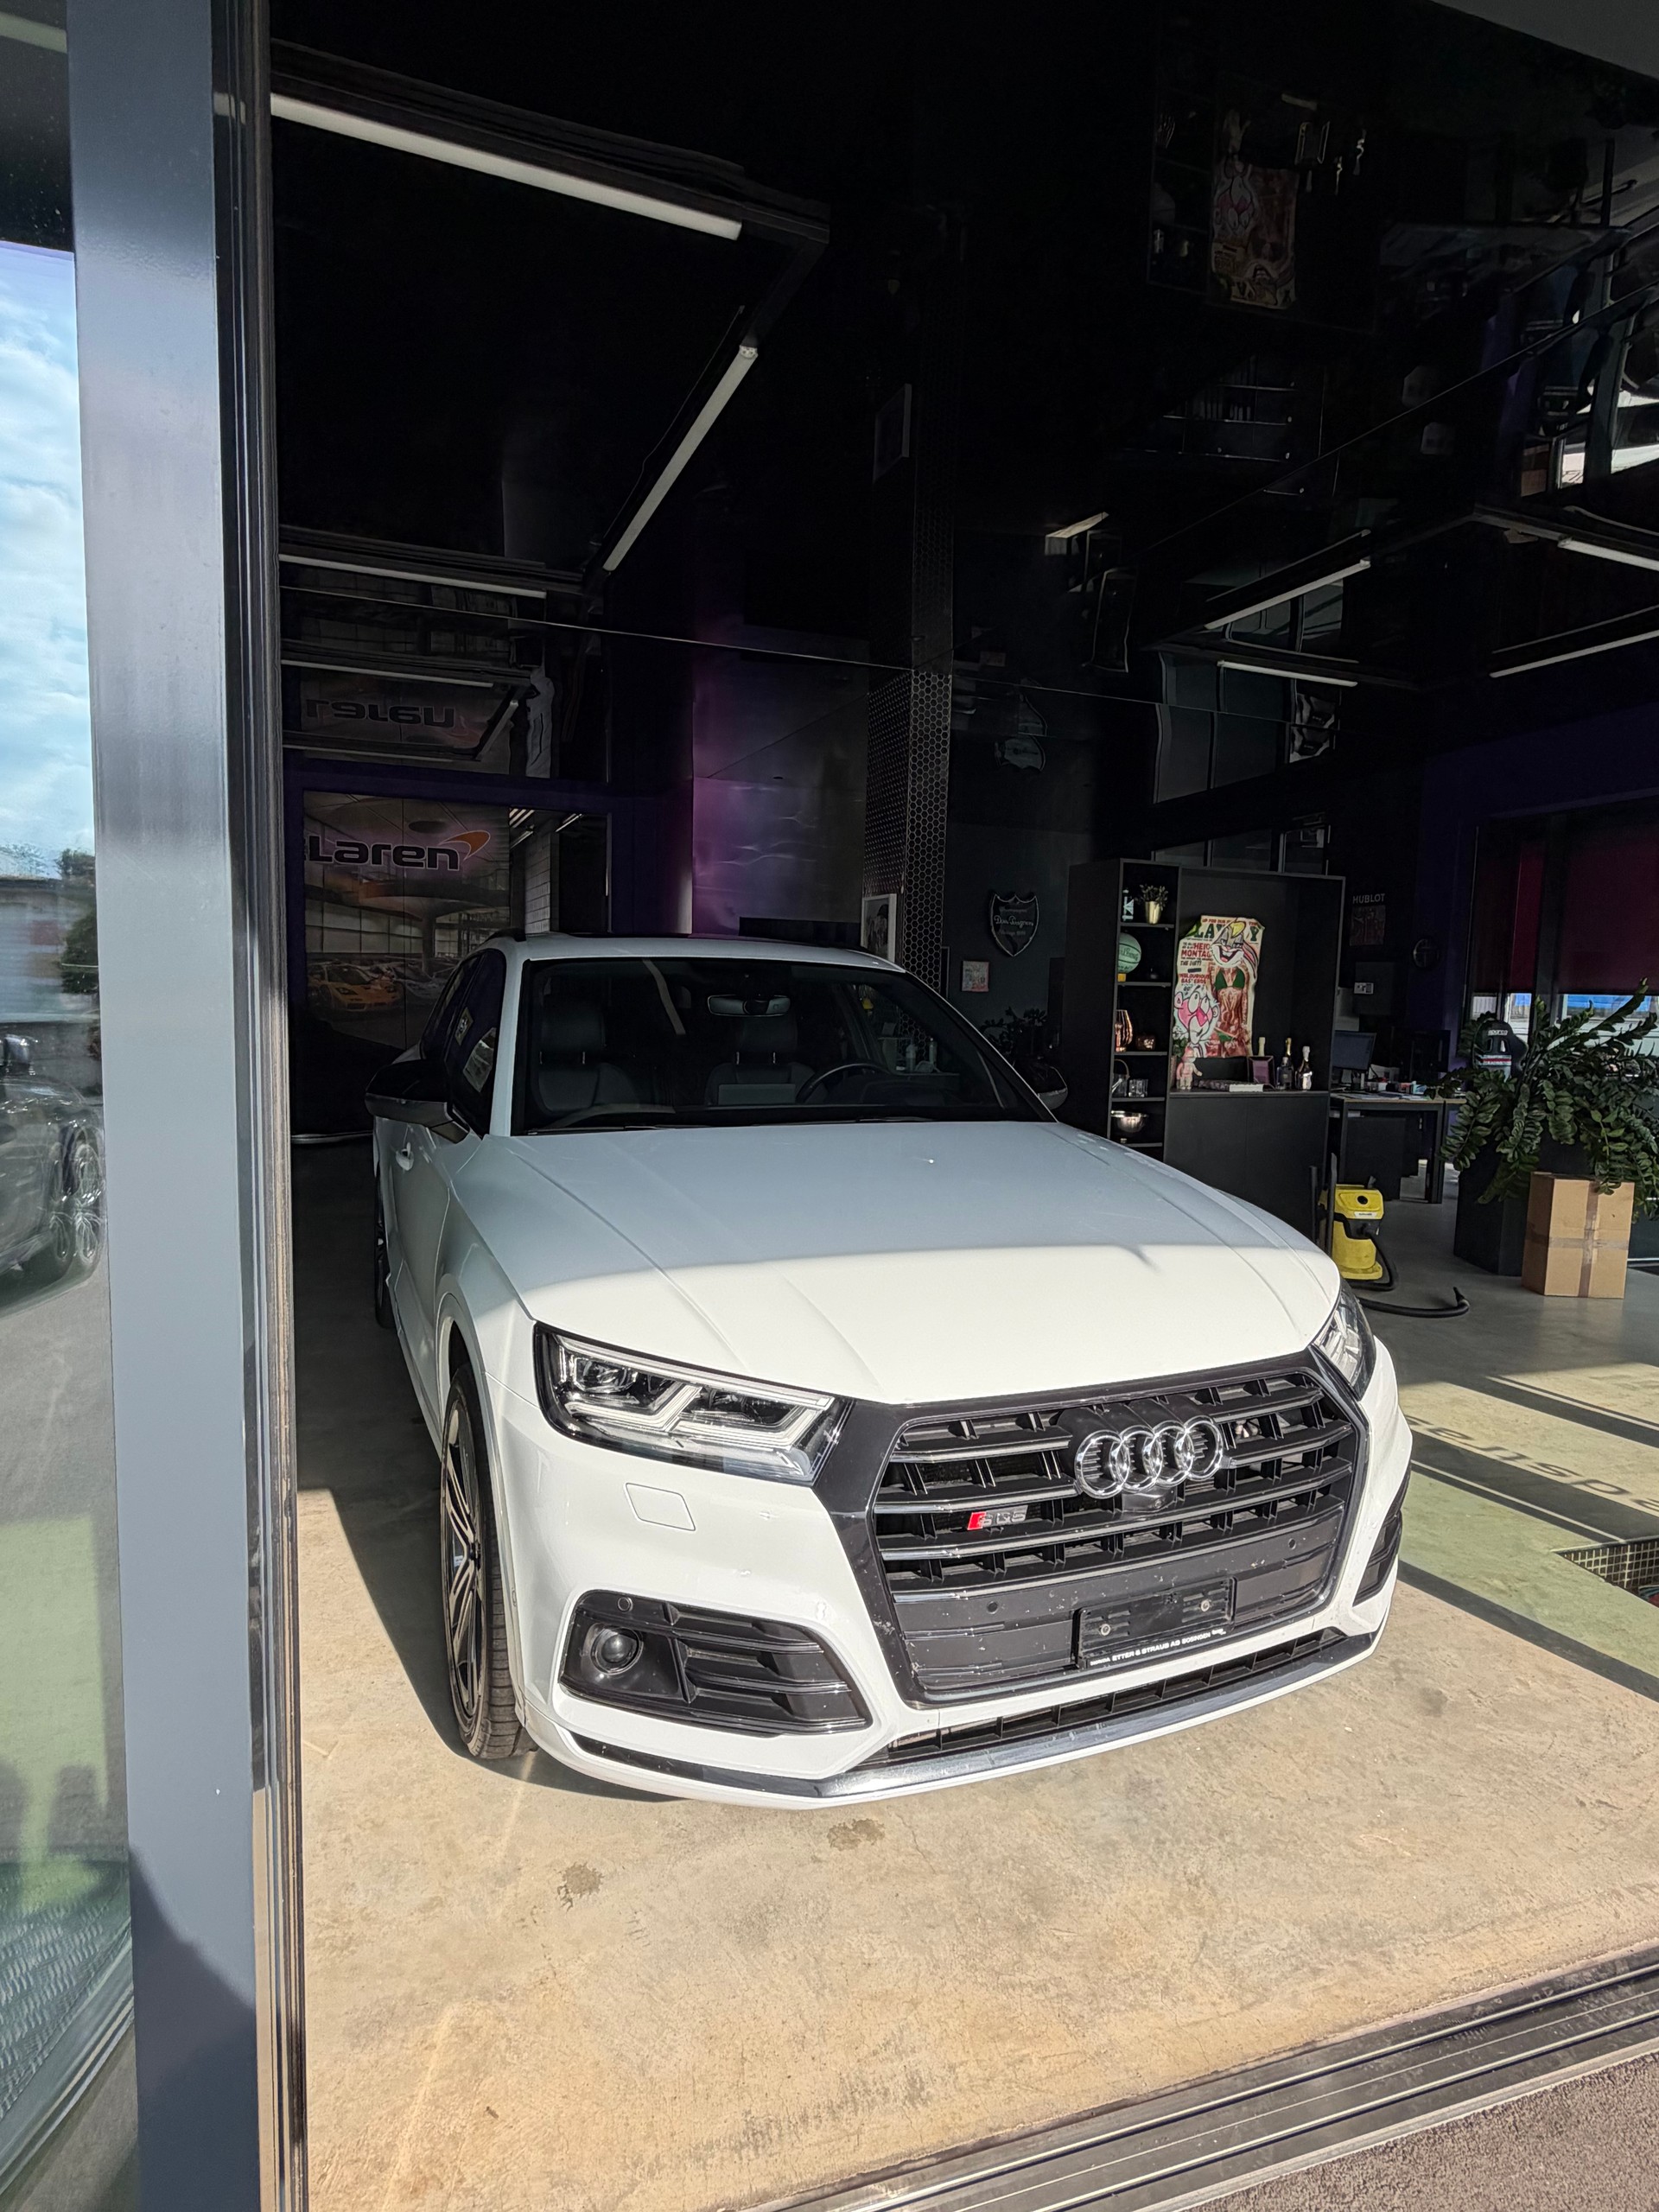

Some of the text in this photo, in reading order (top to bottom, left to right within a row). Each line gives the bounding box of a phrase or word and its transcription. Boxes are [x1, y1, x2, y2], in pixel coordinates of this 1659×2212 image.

[305, 835, 460, 872] Laren
[1352, 893, 1386, 905] HUBLOT
[976, 1508, 1028, 1529] SQ5
[1111, 1650, 1135, 1662] ETTER
[1141, 1642, 1170, 1655] STRAUB
